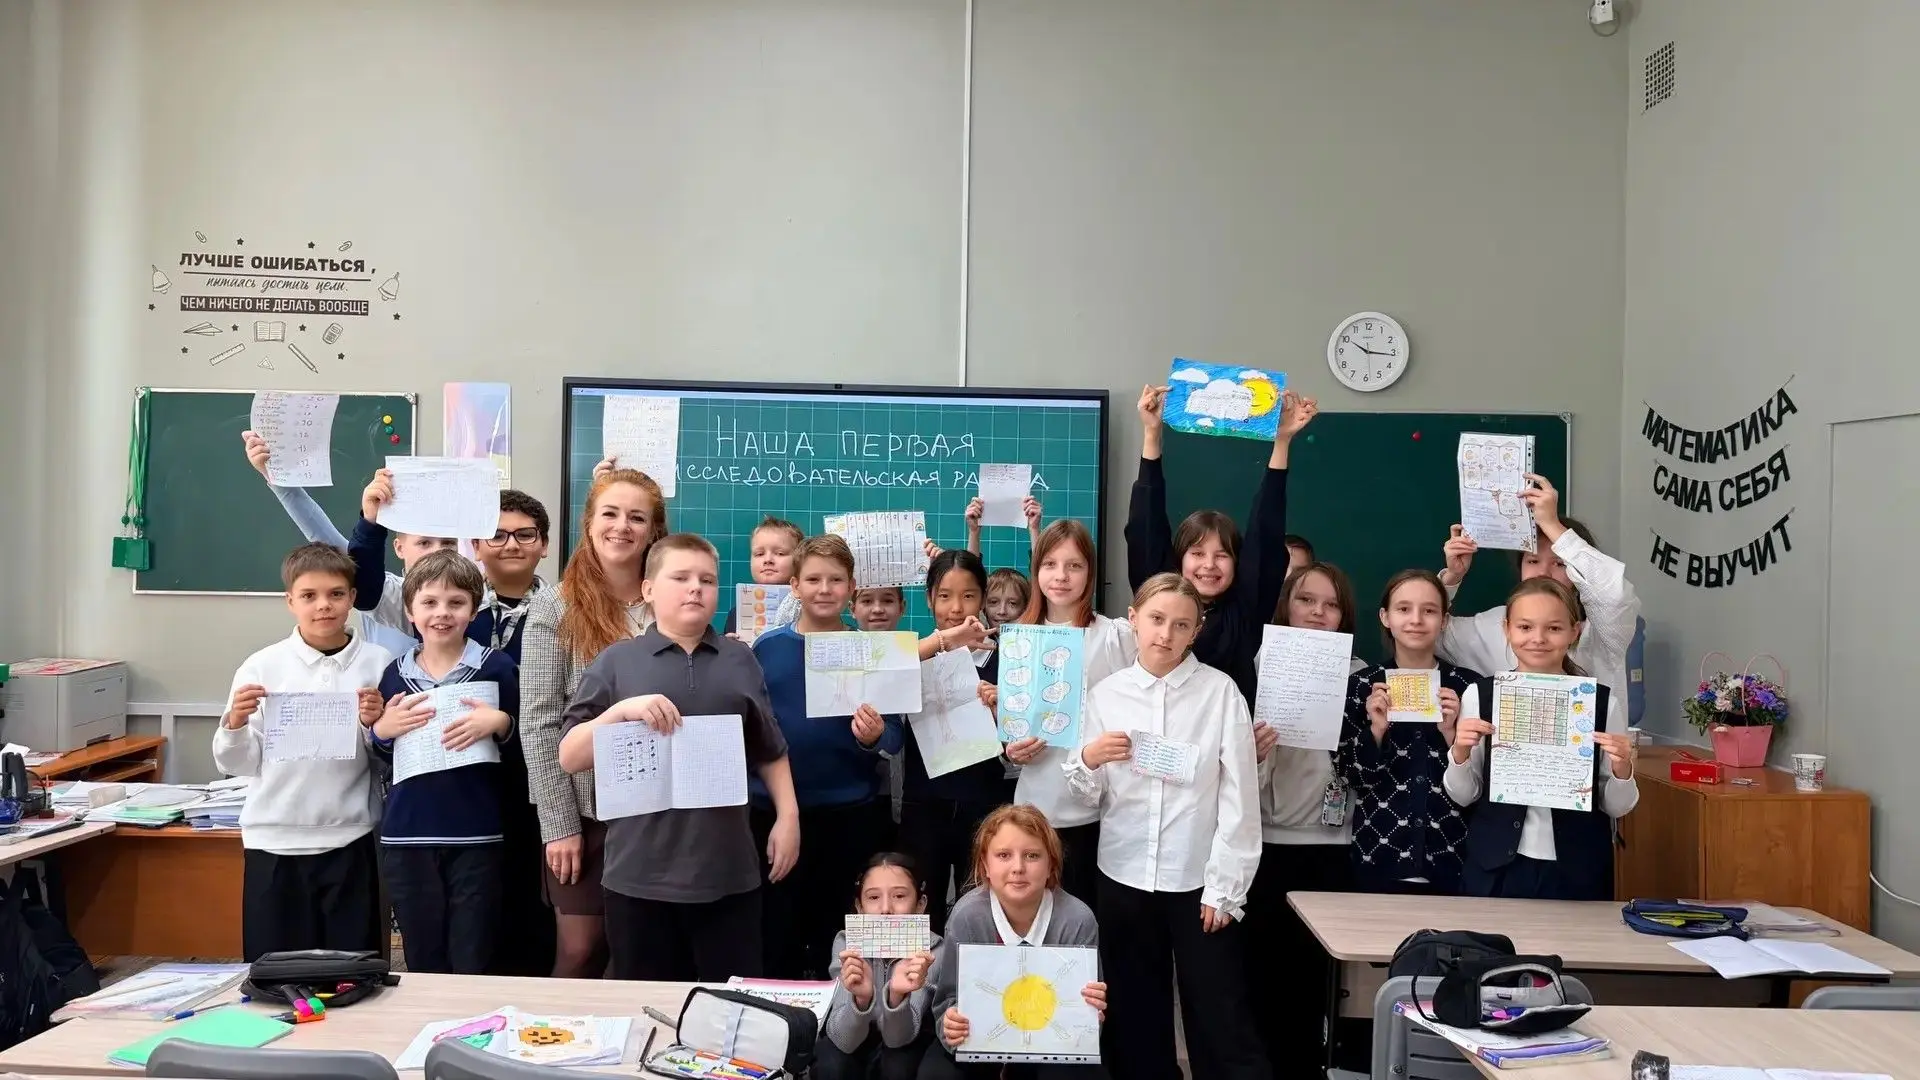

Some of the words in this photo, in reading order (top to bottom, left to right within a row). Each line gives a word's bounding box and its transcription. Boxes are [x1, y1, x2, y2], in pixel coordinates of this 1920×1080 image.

[179, 253, 245, 268] ЛУЧШЕ
[260, 279, 310, 294] достичь
[315, 280, 349, 294] цели.
[182, 296, 206, 309] ЧЕМ
[209, 297, 253, 310] НИЧЕГО
[256, 299, 271, 310] НЕ
[273, 299, 315, 312] ДЕЛАТЬ
[319, 301, 368, 314] ВООБЩЕ
[1365, 322, 1373, 331] 12
[1342, 335, 1350, 343] 10
[1641, 387, 1798, 464] МАТЕМАТИКА
[716, 415, 815, 459] НАША
[841, 430, 975, 462] ПЕРВАЯ
[954, 470, 1050, 491] РАА
[1653, 464, 1714, 513] САМА
[1718, 448, 1791, 511] СЕБЯ
[1650, 534, 1681, 579] НЕ
[1686, 513, 1792, 588] ВЫУЧИТ
